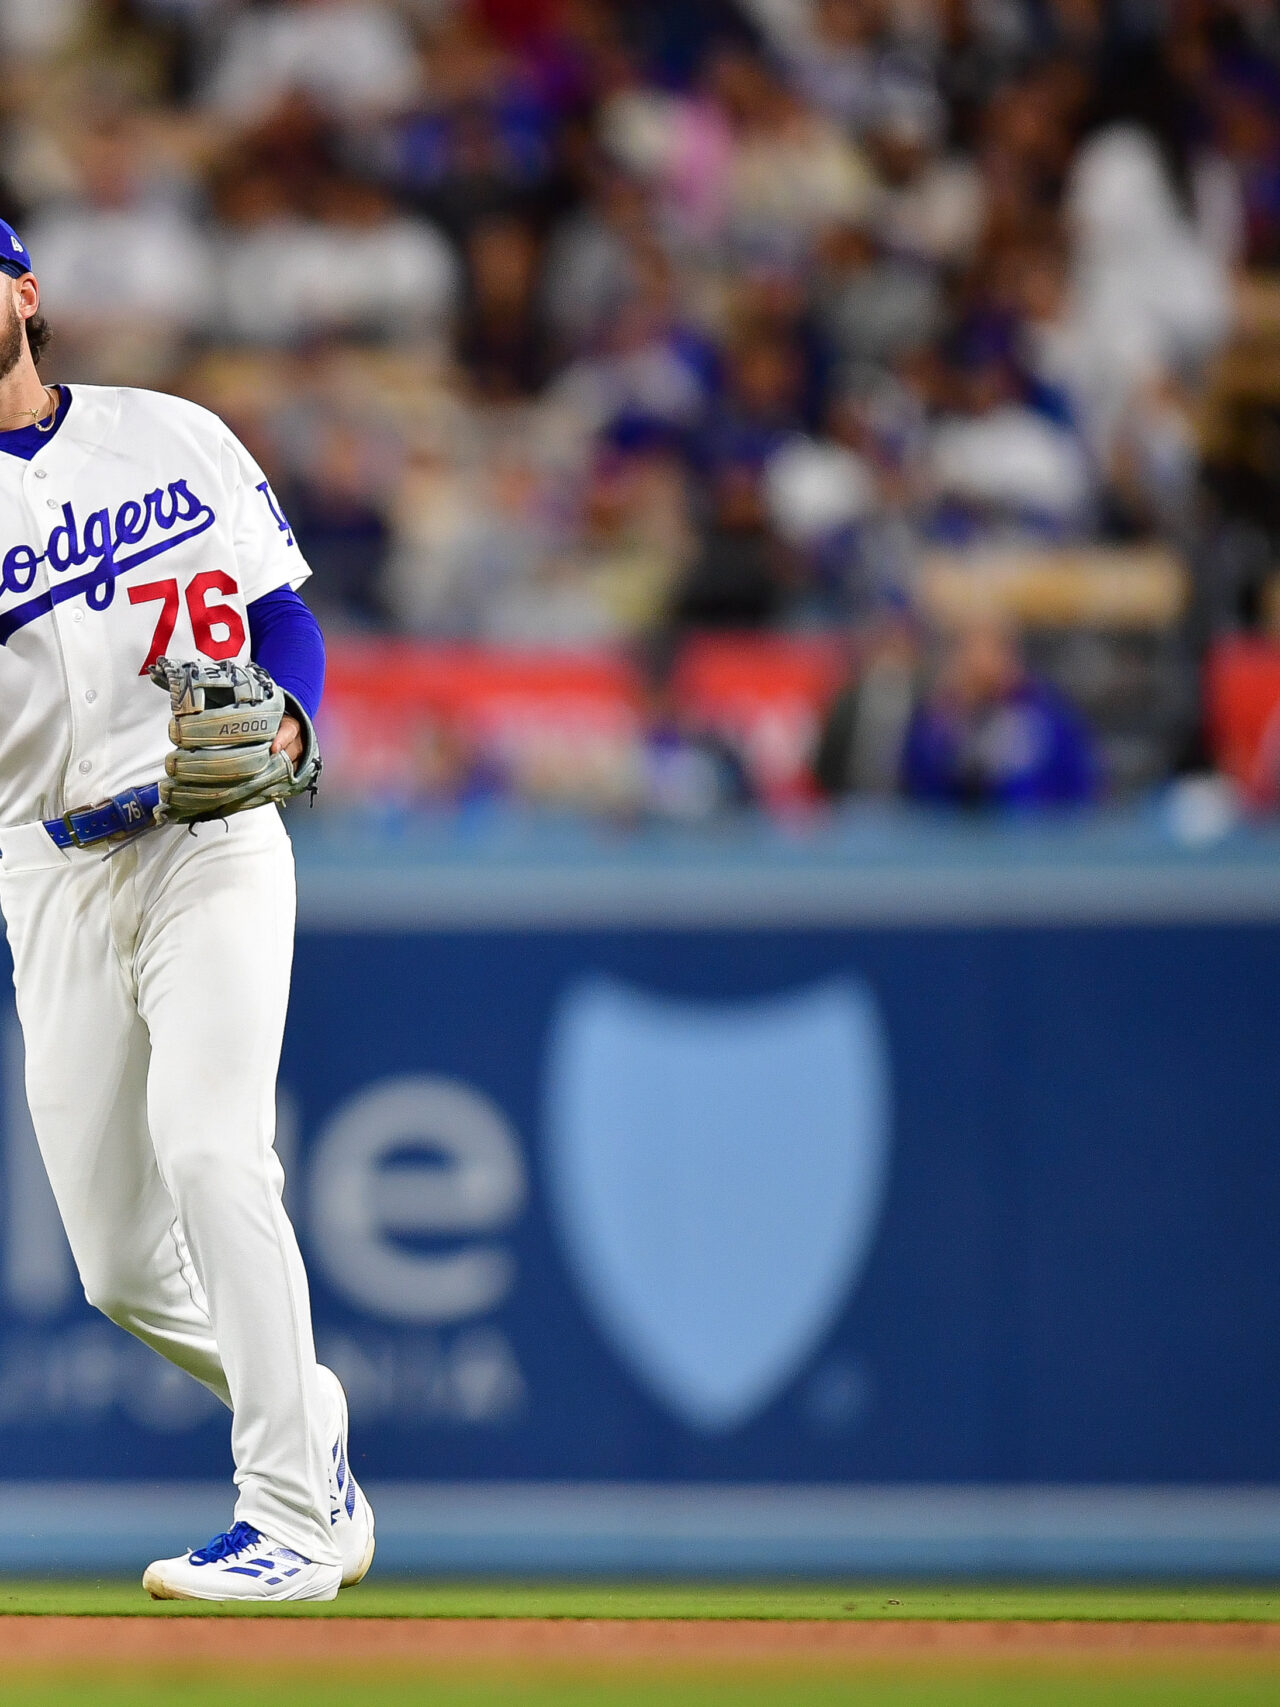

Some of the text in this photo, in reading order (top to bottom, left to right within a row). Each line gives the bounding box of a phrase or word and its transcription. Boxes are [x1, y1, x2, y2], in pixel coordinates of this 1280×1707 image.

[127, 569, 247, 676] 76
[219, 719, 268, 736] A2000
[122, 801, 141, 823] 76
